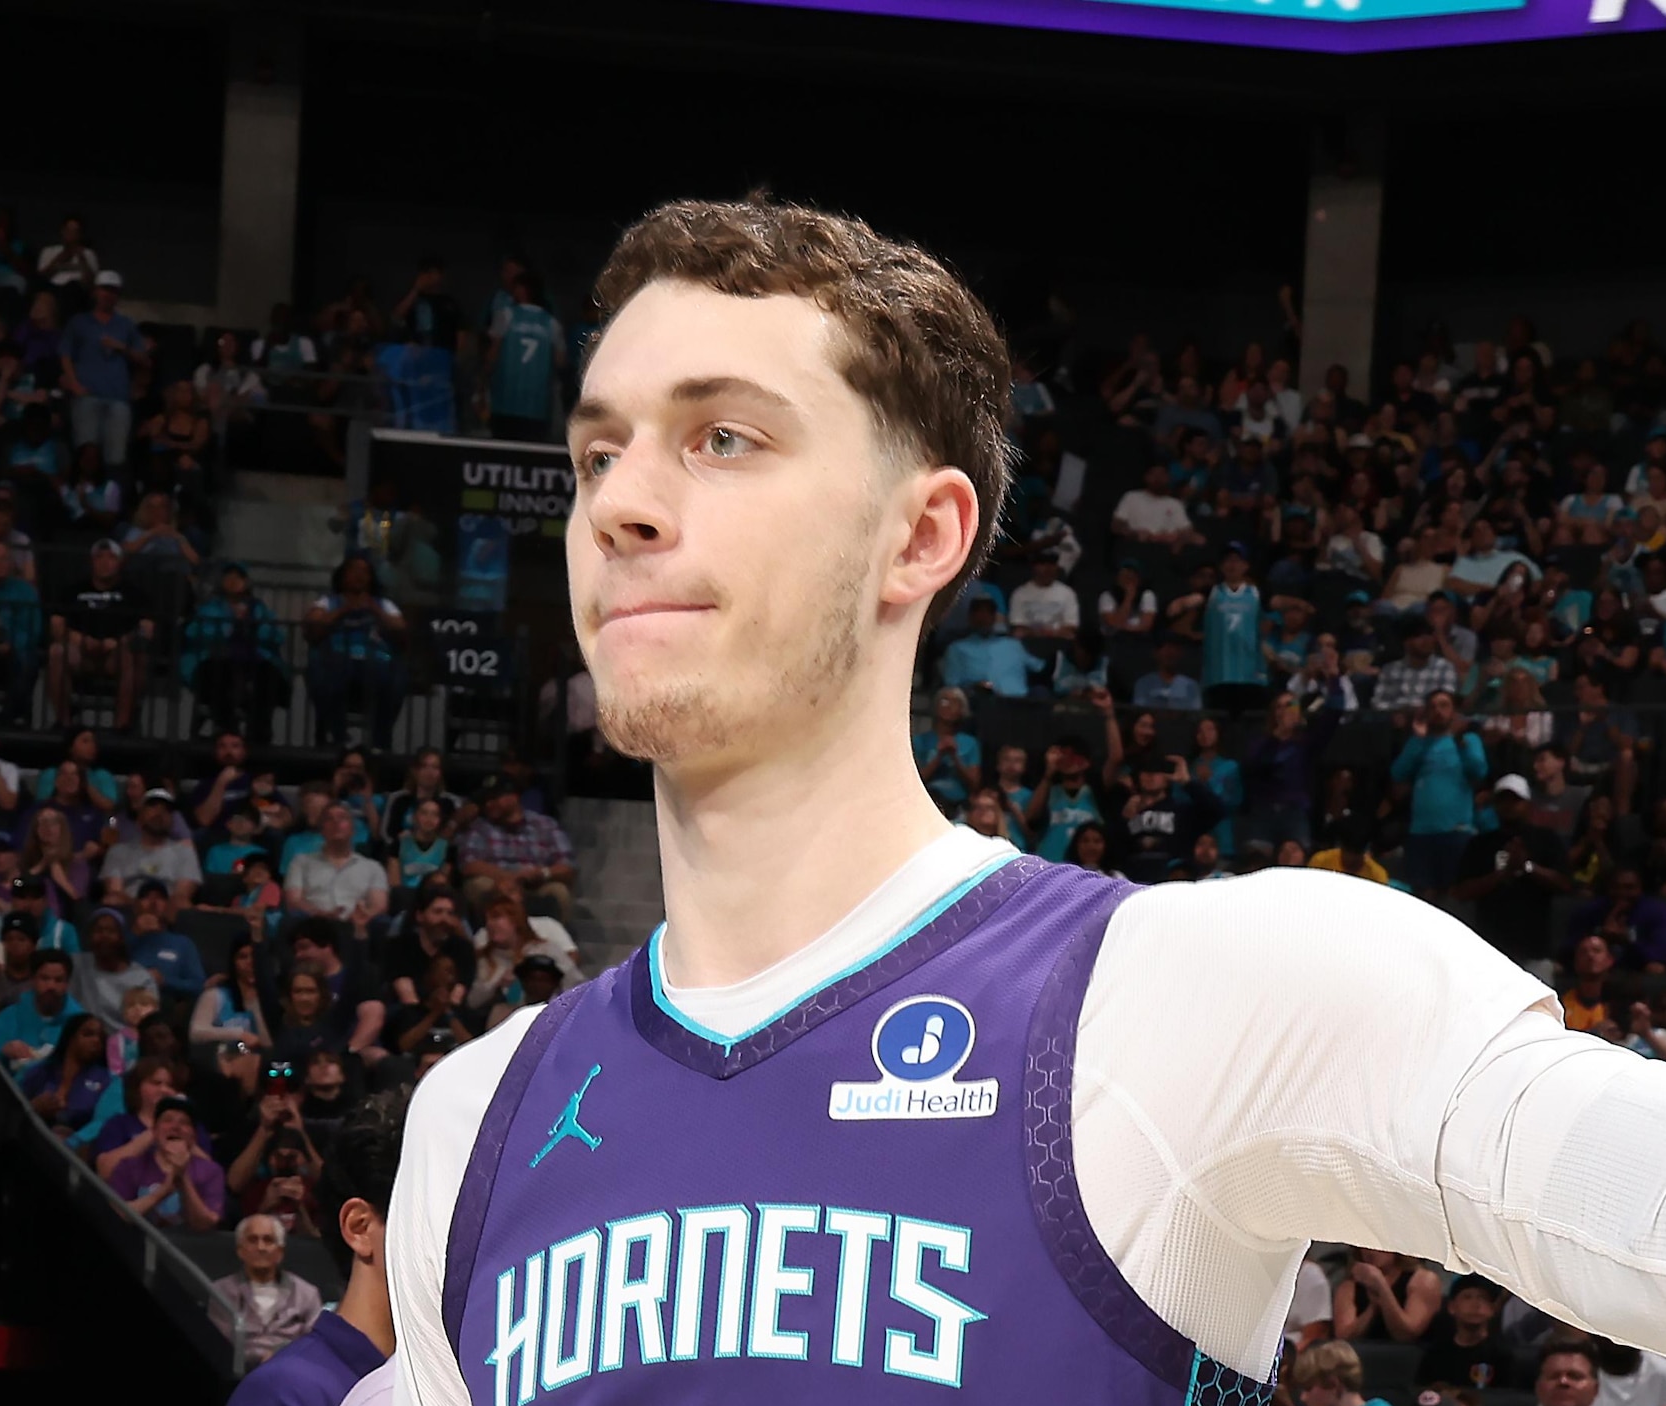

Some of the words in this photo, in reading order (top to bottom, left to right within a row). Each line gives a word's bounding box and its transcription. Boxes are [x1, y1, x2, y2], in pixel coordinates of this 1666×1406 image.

[462, 462, 574, 491] UTILITY
[446, 647, 499, 677] 102
[836, 1089, 902, 1114] Judi
[907, 1087, 993, 1113] Health
